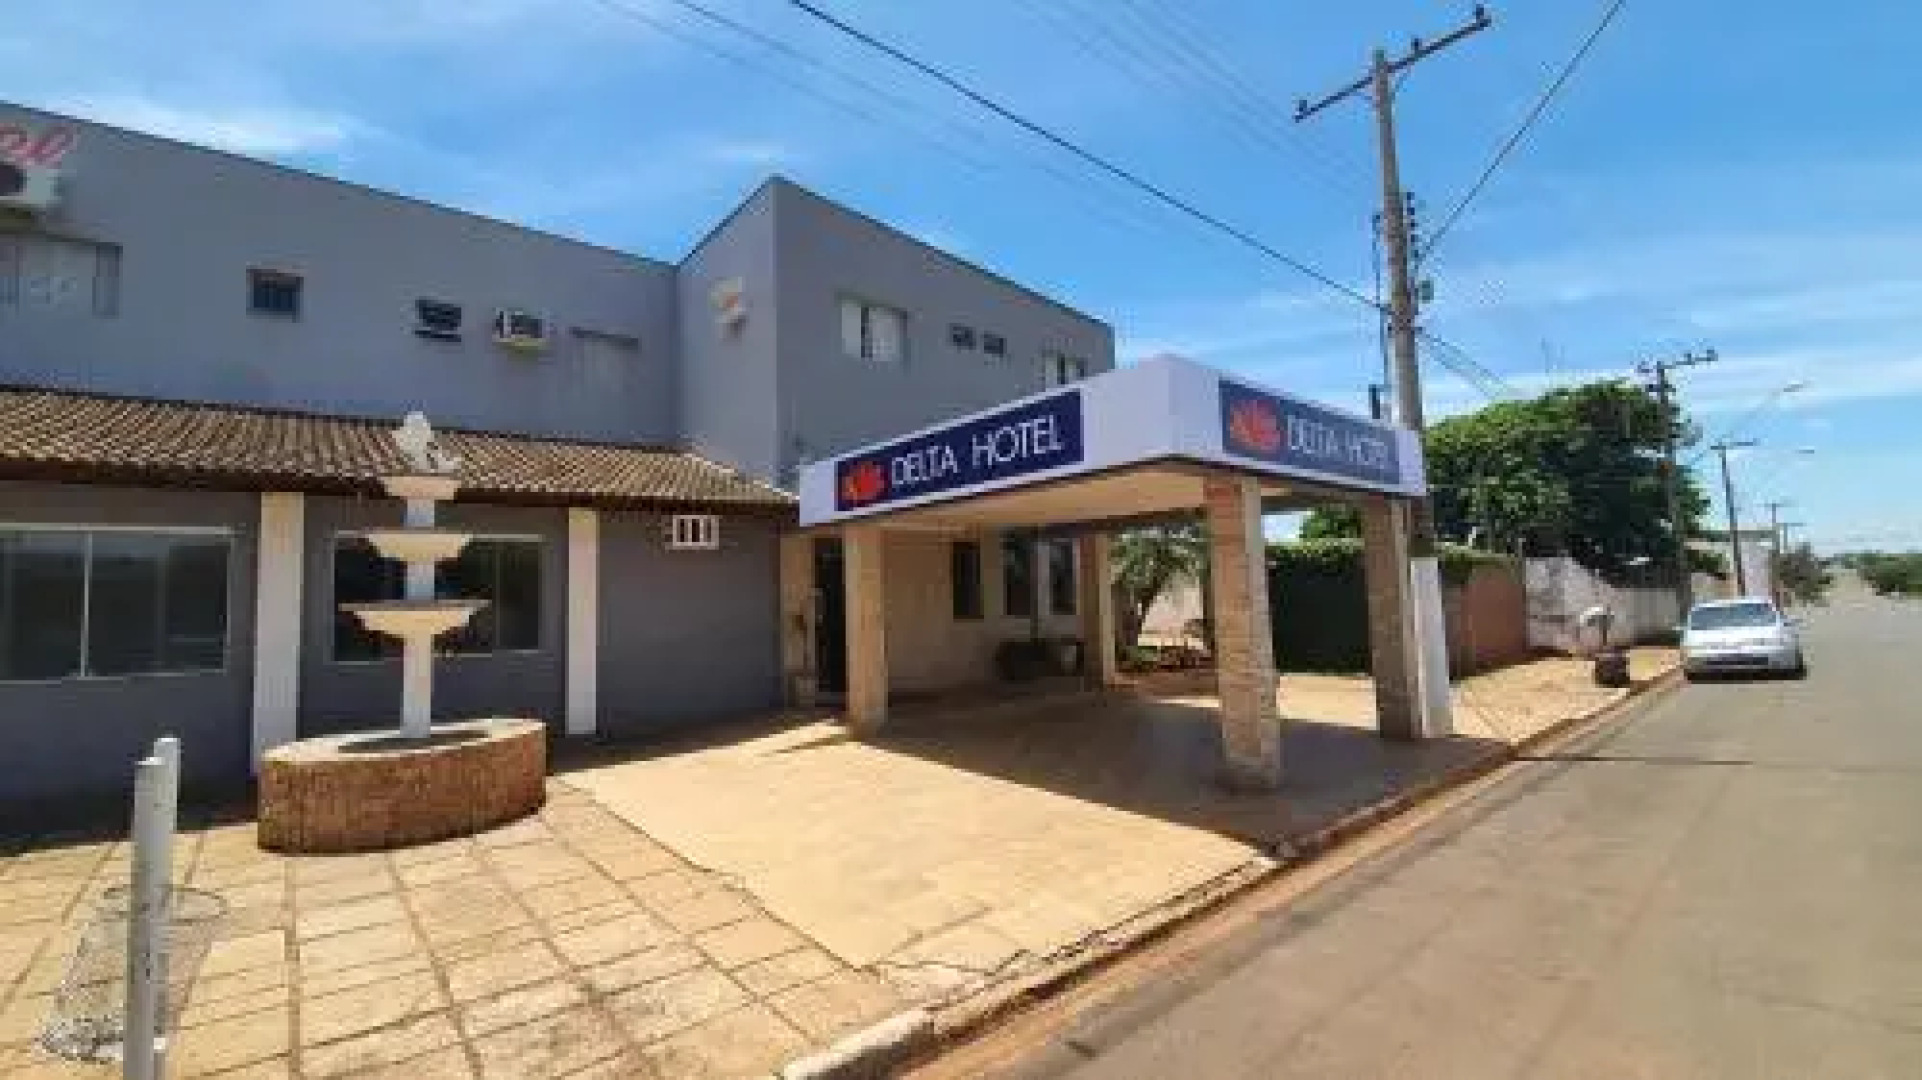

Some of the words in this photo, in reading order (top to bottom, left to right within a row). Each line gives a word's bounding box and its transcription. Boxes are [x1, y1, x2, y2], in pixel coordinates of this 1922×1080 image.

[891, 445, 958, 485] DELTA
[972, 415, 1061, 466] HOTEL
[1287, 414, 1339, 458] DELTA
